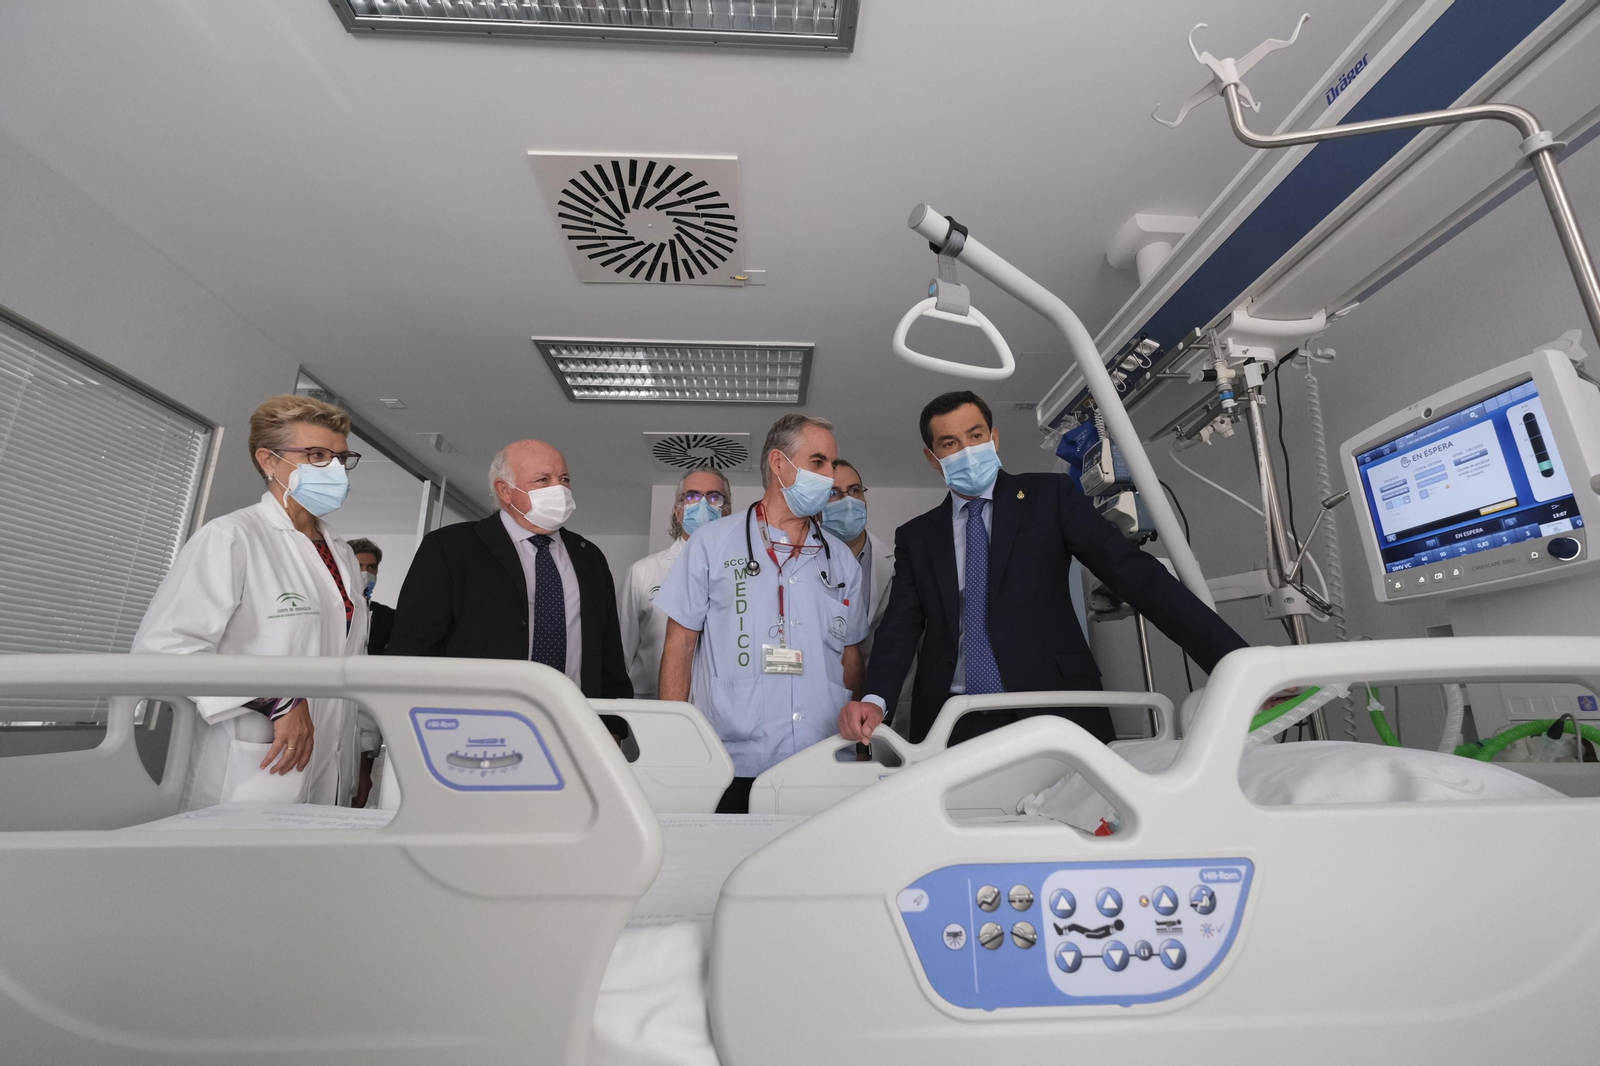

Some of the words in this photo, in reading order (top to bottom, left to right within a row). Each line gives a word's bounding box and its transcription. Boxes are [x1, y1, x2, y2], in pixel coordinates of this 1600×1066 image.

[1325, 53, 1368, 106] Dräger
[1412, 452, 1423, 462] EN
[1423, 441, 1454, 457] ESPERA
[1462, 527, 1484, 538] ESPERA
[734, 567, 750, 667] MEDICO
[427, 721, 457, 729] Hill-Rom
[1202, 870, 1240, 881] Hill-Rom
